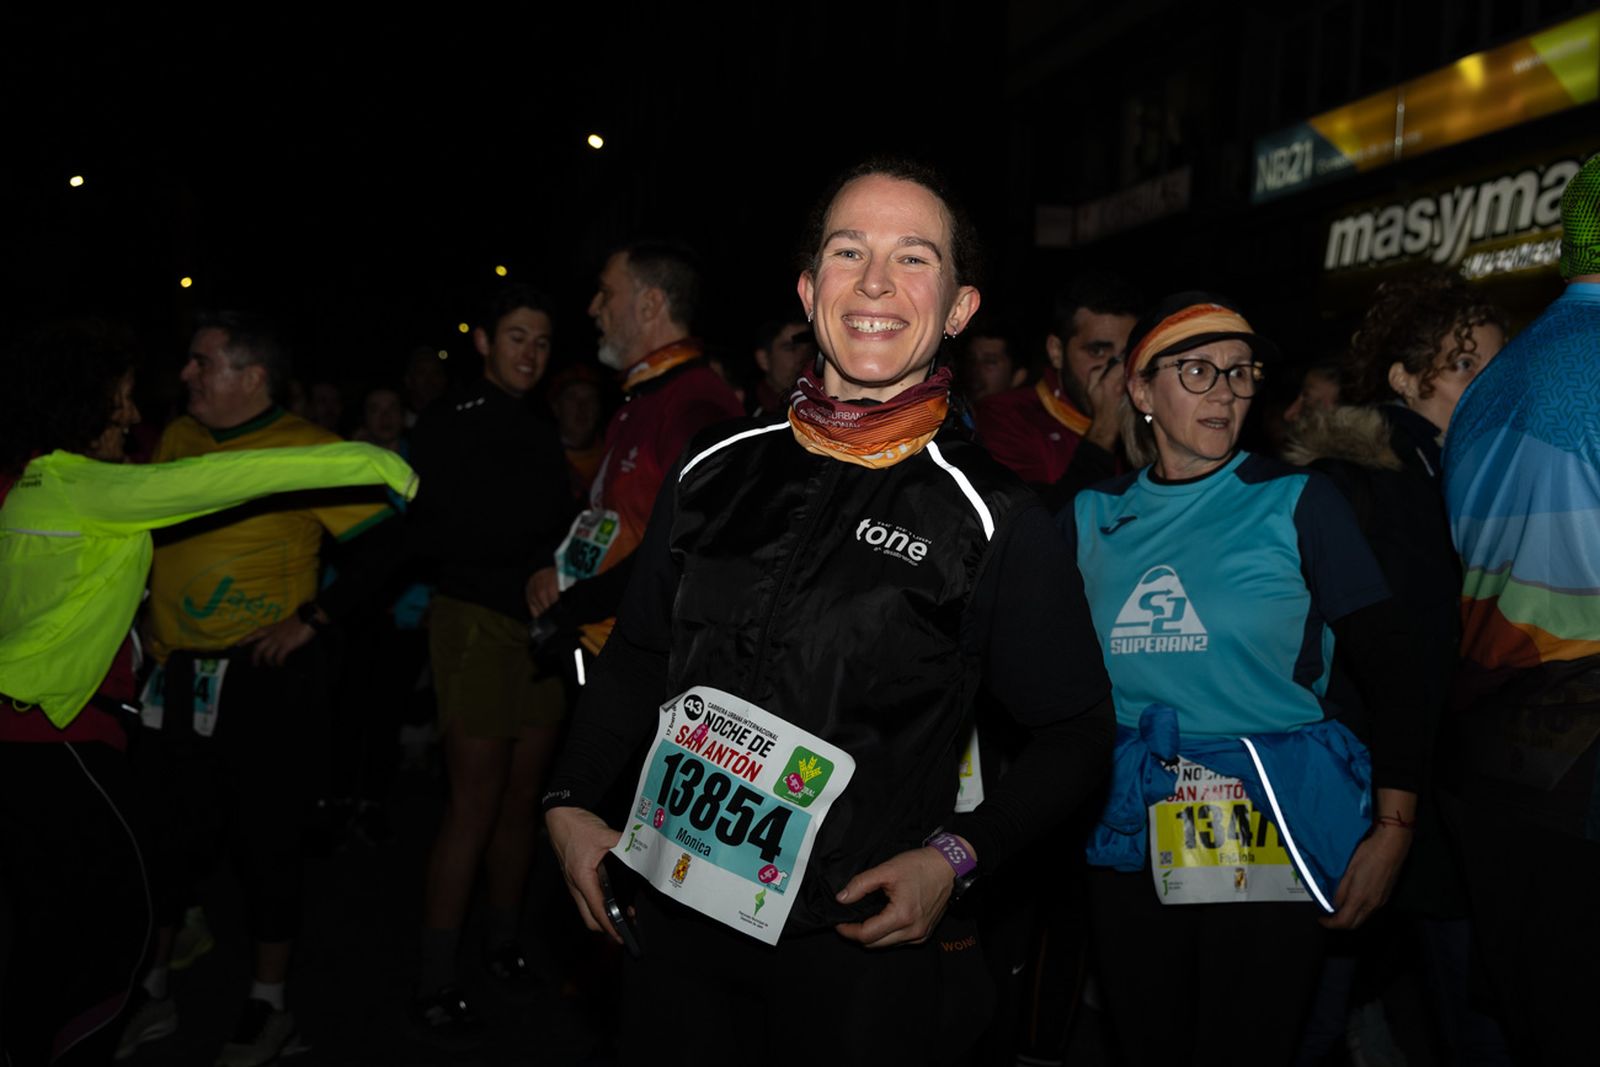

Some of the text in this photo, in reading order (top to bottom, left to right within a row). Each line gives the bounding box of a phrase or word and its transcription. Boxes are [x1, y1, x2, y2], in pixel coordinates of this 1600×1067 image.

[1255, 139, 1314, 194] NB21
[1323, 158, 1581, 271] masyma
[856, 518, 928, 561] tone
[1110, 635, 1208, 655] SUPERAN2
[684, 699, 703, 715] 43
[707, 702, 779, 741] CARRERA URBANA INTERNACIONAL
[703, 710, 752, 746] NOCHE
[747, 734, 776, 758] DE
[702, 740, 763, 782] ANTÓN
[656, 751, 793, 864] 13854
[1166, 780, 1249, 802] AN ANTÓ
[676, 827, 712, 857] Monica
[1175, 803, 1286, 849] 1347
